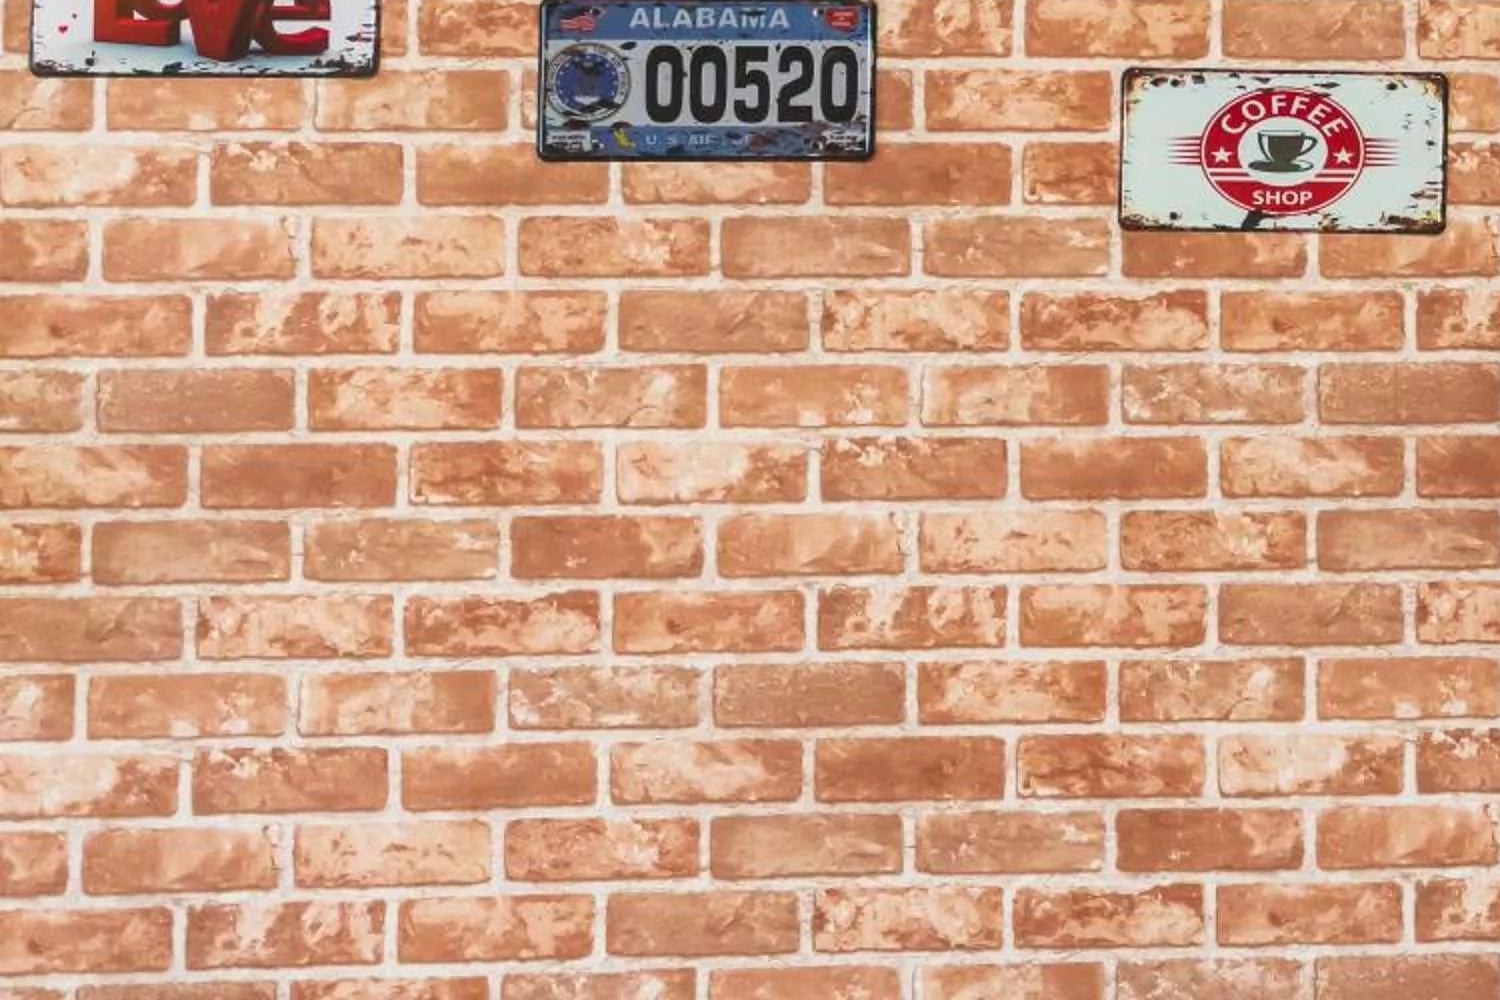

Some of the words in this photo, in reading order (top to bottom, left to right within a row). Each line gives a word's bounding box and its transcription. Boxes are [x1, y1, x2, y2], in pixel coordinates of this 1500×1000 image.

[630, 7, 790, 29] ALABAMA
[645, 45, 859, 124] 00520
[1221, 94, 1348, 137] COFFEE
[1252, 189, 1313, 206] SHOP
